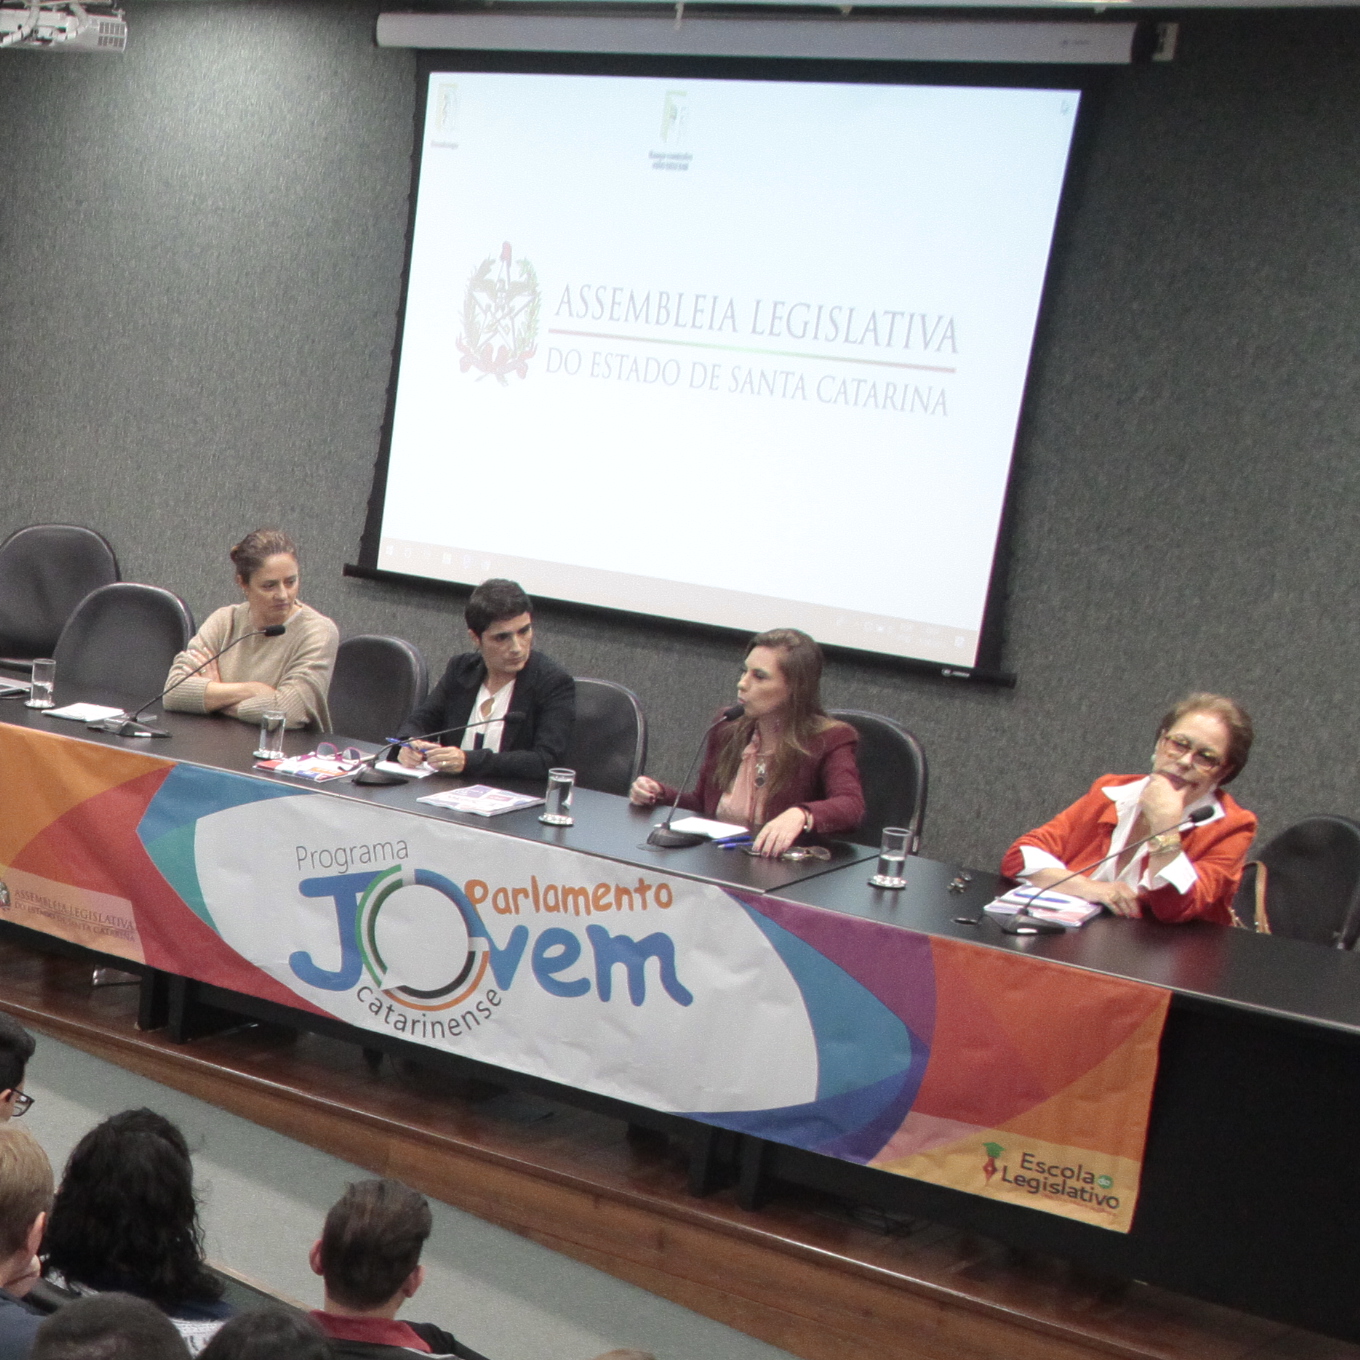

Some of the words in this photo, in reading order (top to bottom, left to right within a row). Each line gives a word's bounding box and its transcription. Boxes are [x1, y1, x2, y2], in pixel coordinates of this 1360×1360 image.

[555, 283, 738, 333] ASSEMBLEIA
[750, 299, 958, 353] LEGISLATIVA
[546, 347, 582, 375] DO
[590, 351, 680, 386] ESTADO
[689, 361, 721, 391] DE
[728, 365, 807, 401] SANTA
[817, 374, 948, 417] CATARINA
[295, 839, 409, 874] Programa
[14, 889, 67, 912] ASSEMBLEIA
[70, 905, 134, 930] LEGISLATIVA
[464, 875, 673, 916] Parlamento
[356, 985, 502, 1039] catarinense
[1001, 1165, 1120, 1209] Legislativo
[1020, 1151, 1095, 1185] Escola
